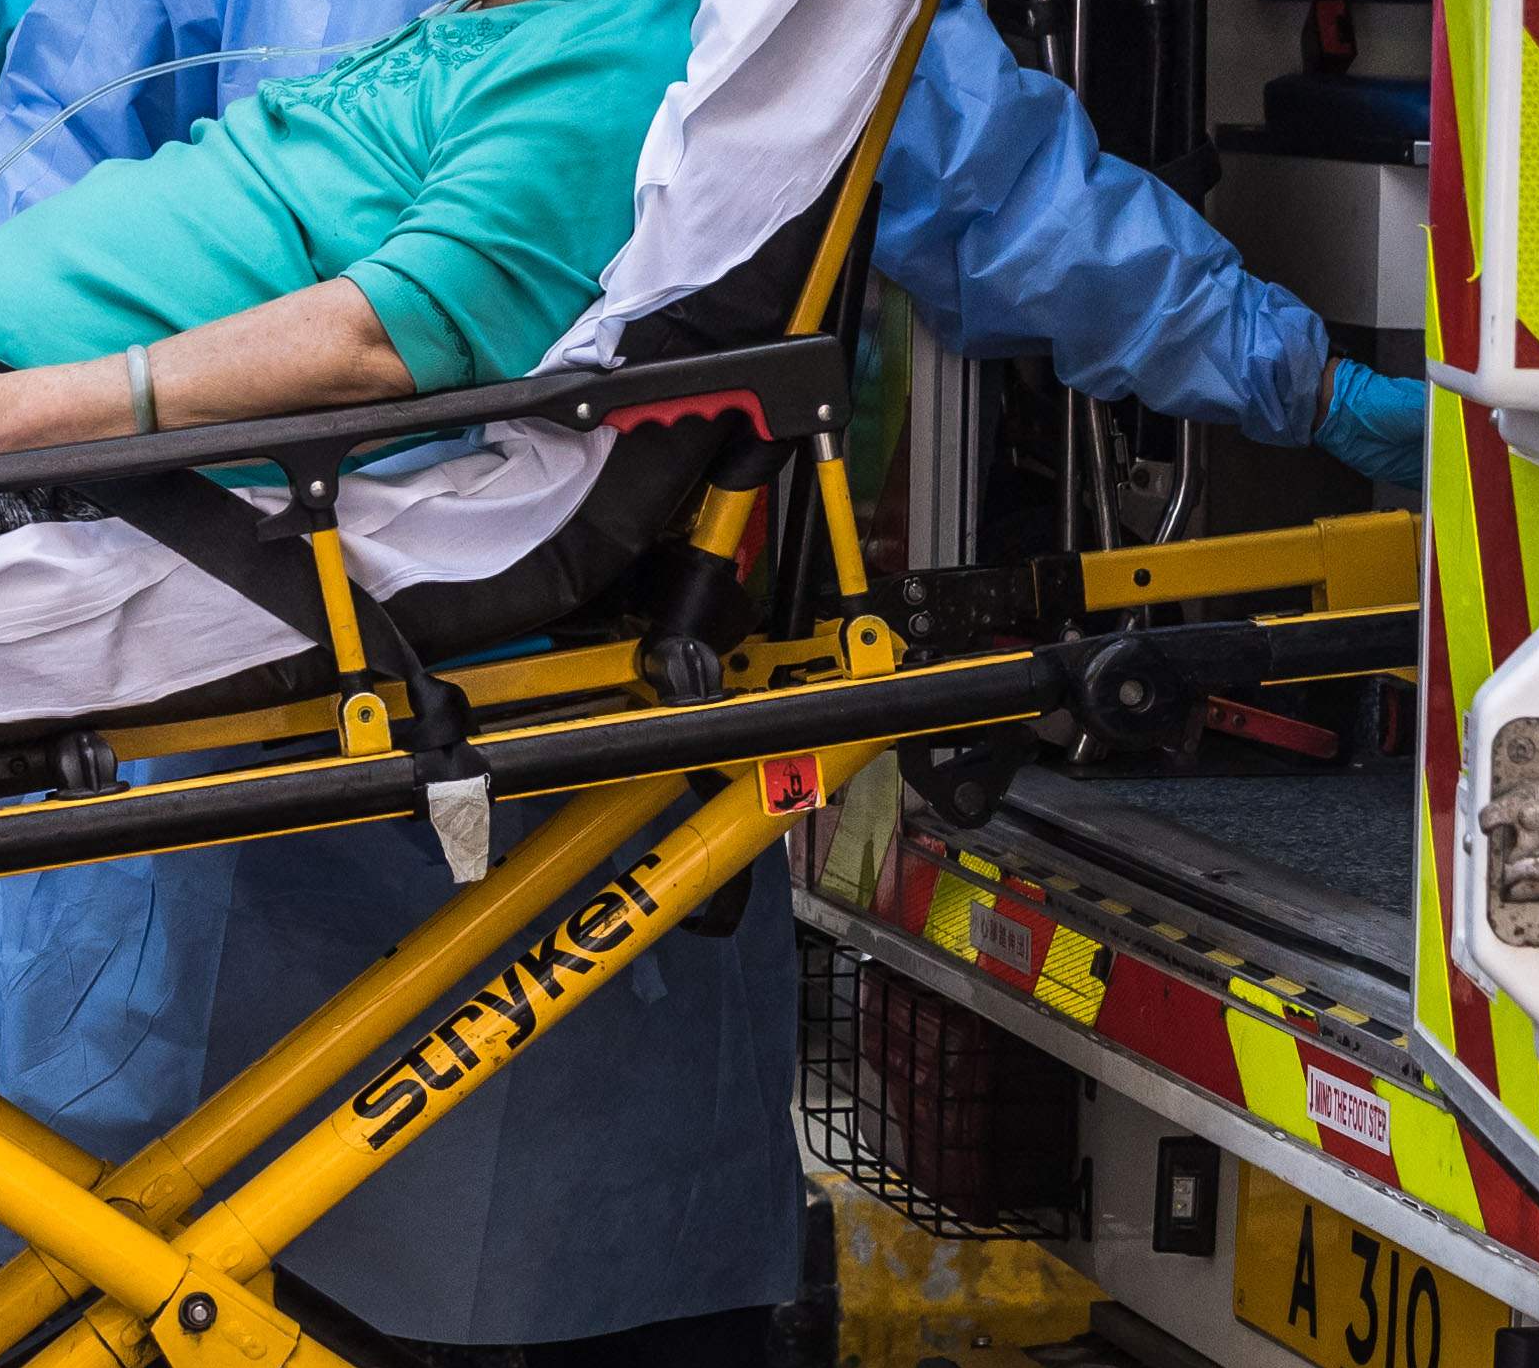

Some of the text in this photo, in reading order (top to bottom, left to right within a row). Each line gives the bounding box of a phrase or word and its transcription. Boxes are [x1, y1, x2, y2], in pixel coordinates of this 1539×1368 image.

[352, 853, 662, 1151] stryker
[1315, 1079, 1386, 1142] MIND THE FOOT STEP
[1288, 1204, 1317, 1339] A
